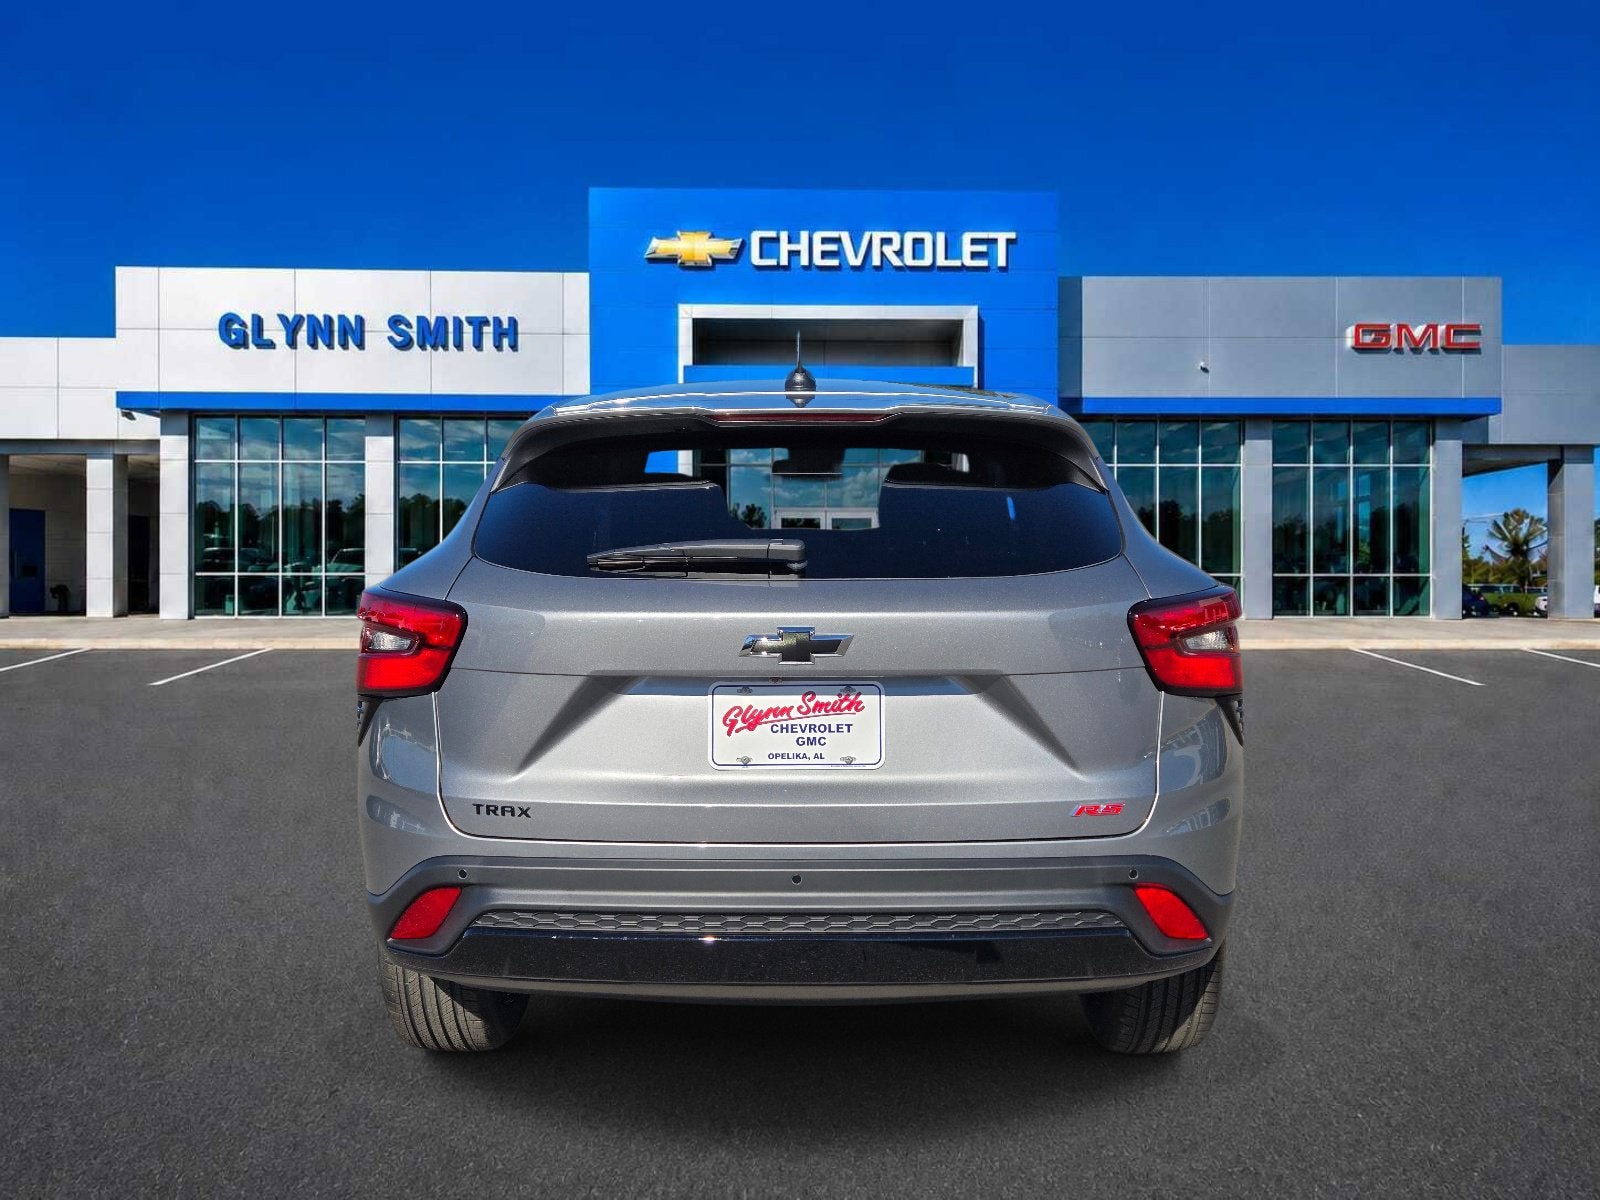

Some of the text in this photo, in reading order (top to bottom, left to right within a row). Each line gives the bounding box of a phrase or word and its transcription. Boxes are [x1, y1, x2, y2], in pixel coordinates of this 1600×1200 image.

[750, 229, 1017, 270] CHEVROLET
[218, 312, 519, 352] GLYNN SMITH
[1350, 322, 1482, 351] GMC
[722, 691, 866, 737] Glynn Smith
[770, 723, 854, 734] CHEVROLET
[795, 736, 827, 747] GMC
[767, 752, 825, 761] OPELIKA, AL
[472, 803, 532, 818] TRAX
[1071, 803, 1125, 817] RS
